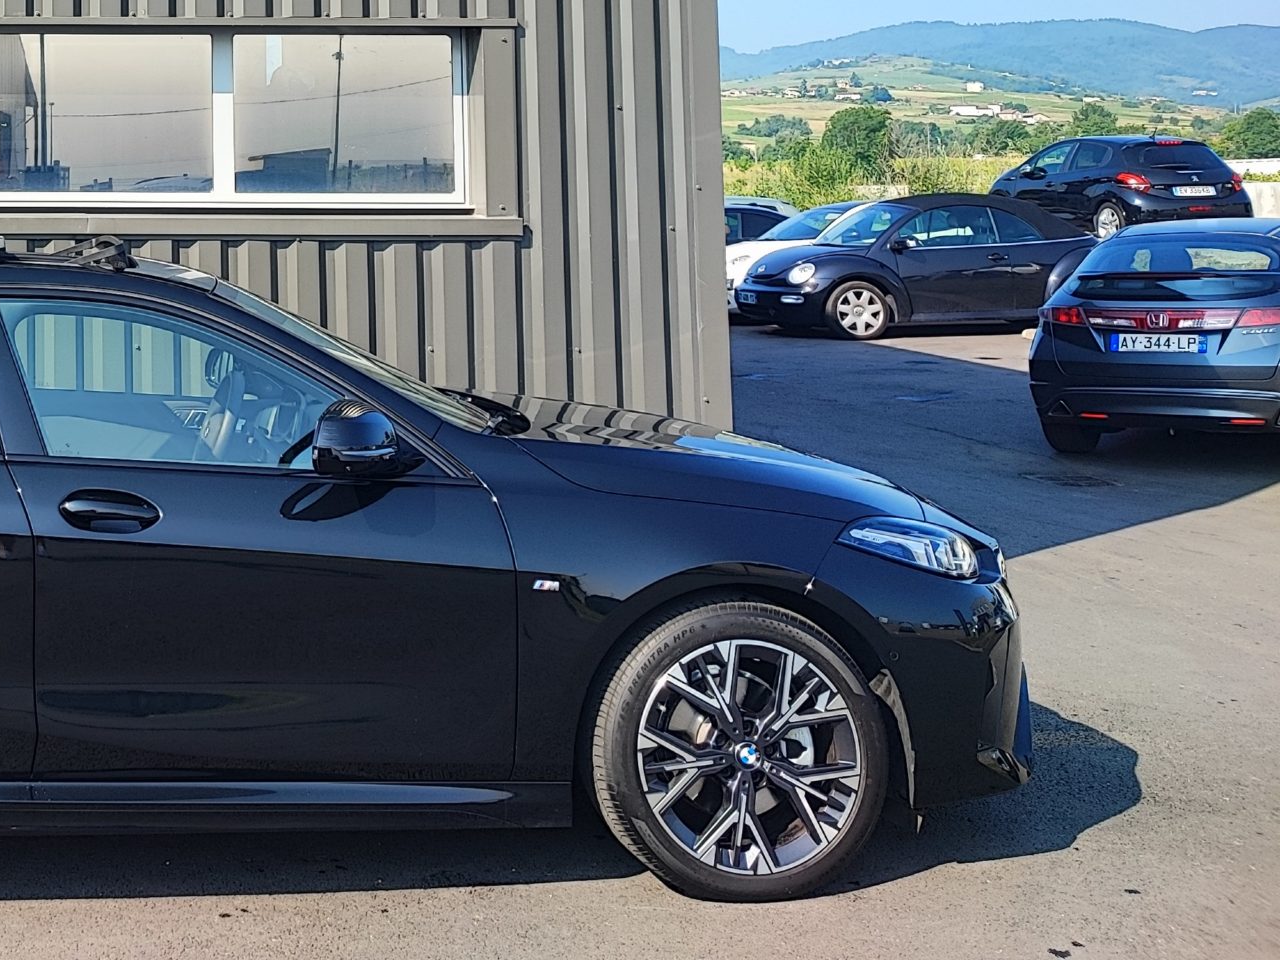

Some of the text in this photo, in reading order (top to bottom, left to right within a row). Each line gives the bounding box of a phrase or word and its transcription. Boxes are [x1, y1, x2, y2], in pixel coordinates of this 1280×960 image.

[1120, 336, 1197, 350] AY-344-LP
[627, 625, 696, 696] PREMITRA HP6
